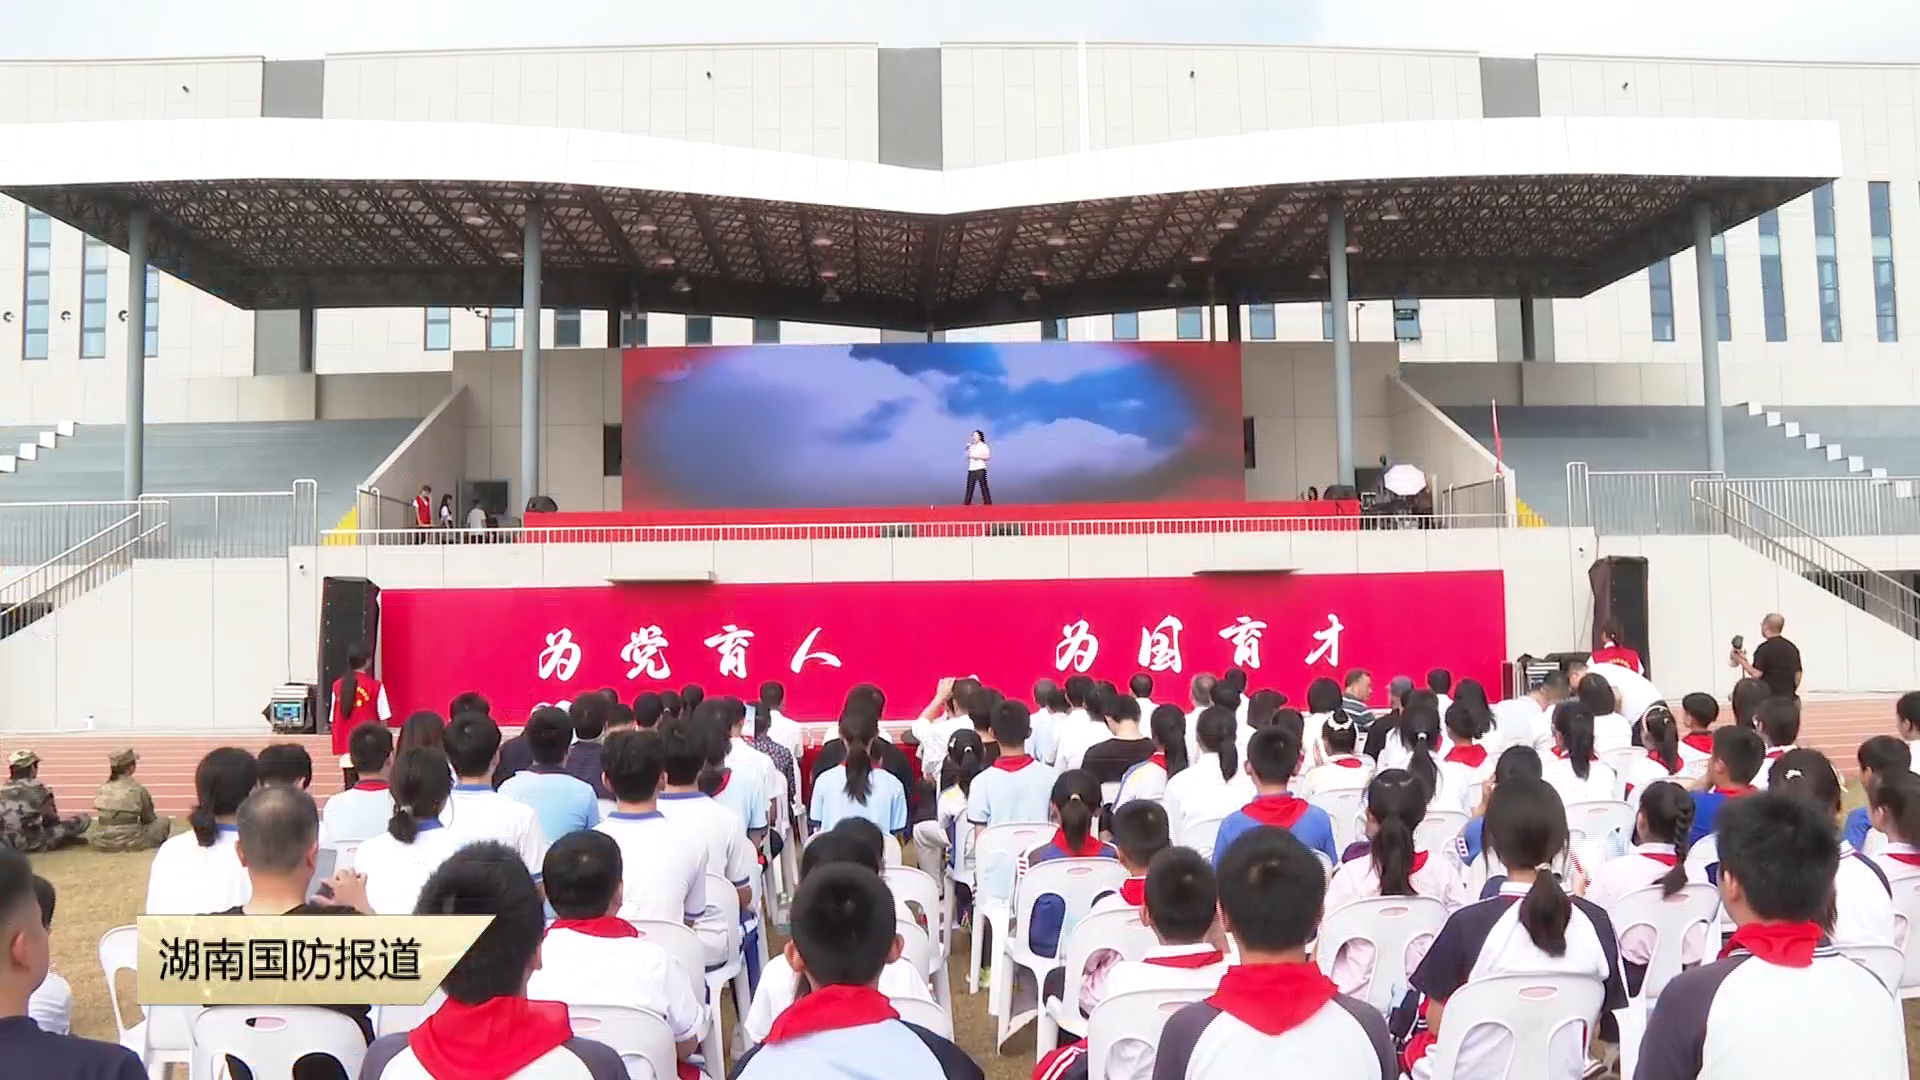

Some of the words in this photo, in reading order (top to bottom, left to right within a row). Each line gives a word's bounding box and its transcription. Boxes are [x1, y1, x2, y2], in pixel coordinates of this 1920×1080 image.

[538, 624, 842, 682] 为党育人
[1055, 613, 1344, 674] 为国育才
